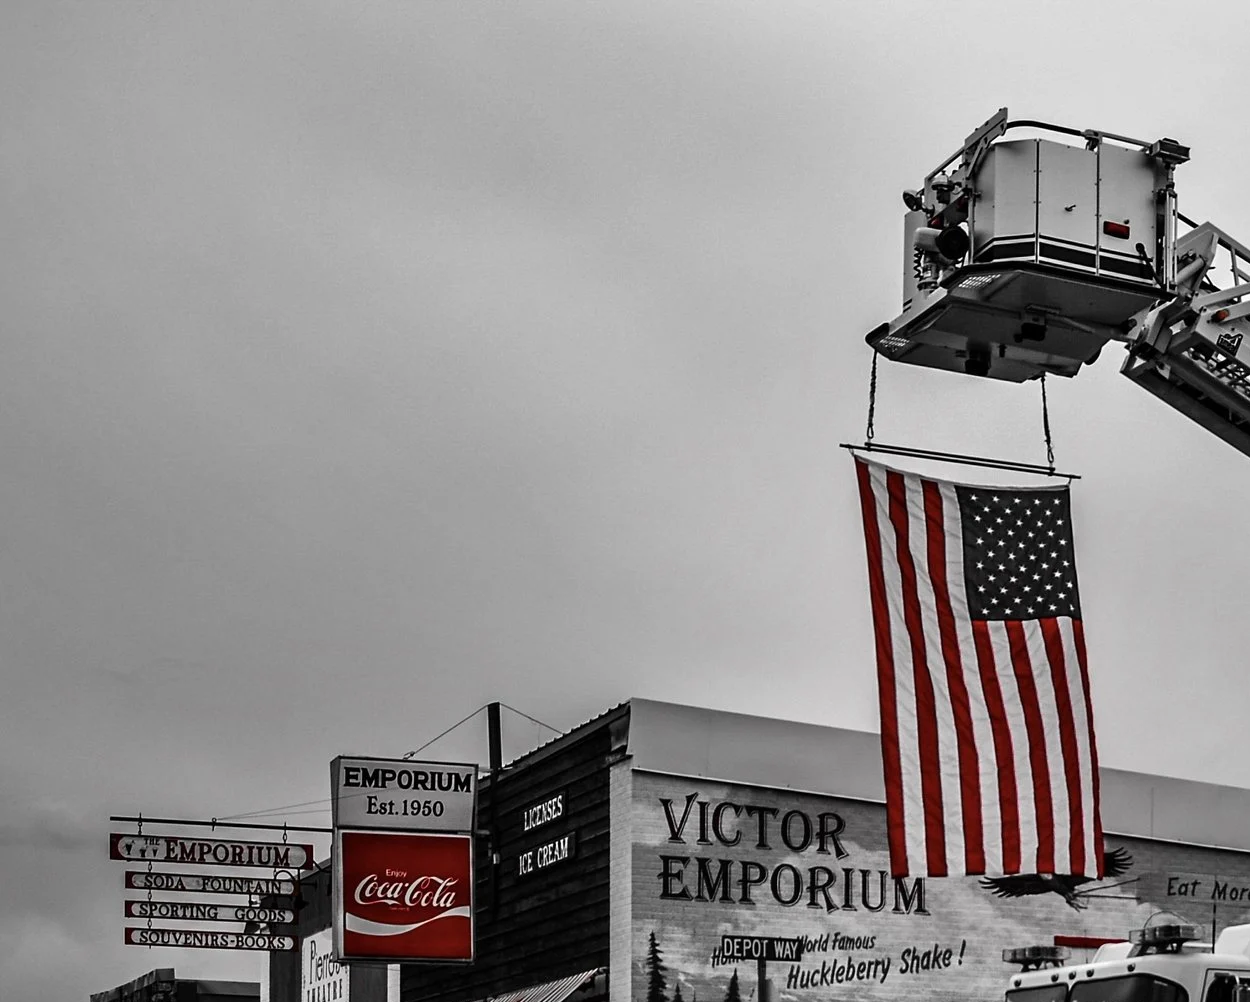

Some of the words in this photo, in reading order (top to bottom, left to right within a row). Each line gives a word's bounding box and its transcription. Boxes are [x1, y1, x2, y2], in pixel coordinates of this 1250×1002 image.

[343, 766, 472, 793] EMPORIUM
[523, 793, 564, 831] LICENSES
[660, 792, 850, 860] VICTOR
[163, 839, 292, 867] EMPORIUM
[518, 854, 534, 876] ICE
[536, 838, 569, 871] CREAM
[143, 875, 186, 890] SODA
[202, 878, 282, 894] FOUNTAIN
[385, 868, 407, 878] Enjoy
[660, 855, 932, 917] EMPORIUM
[1166, 876, 1202, 897] Eat
[139, 903, 218, 919] SPORTING
[235, 908, 286, 922] GOODS
[139, 930, 286, 949] SOUVENIRS-BOOKS
[723, 937, 769, 958] DEPOT
[773, 940, 800, 960] WAY
[831, 931, 877, 951] Famous
[786, 956, 891, 990] Huckleberry
